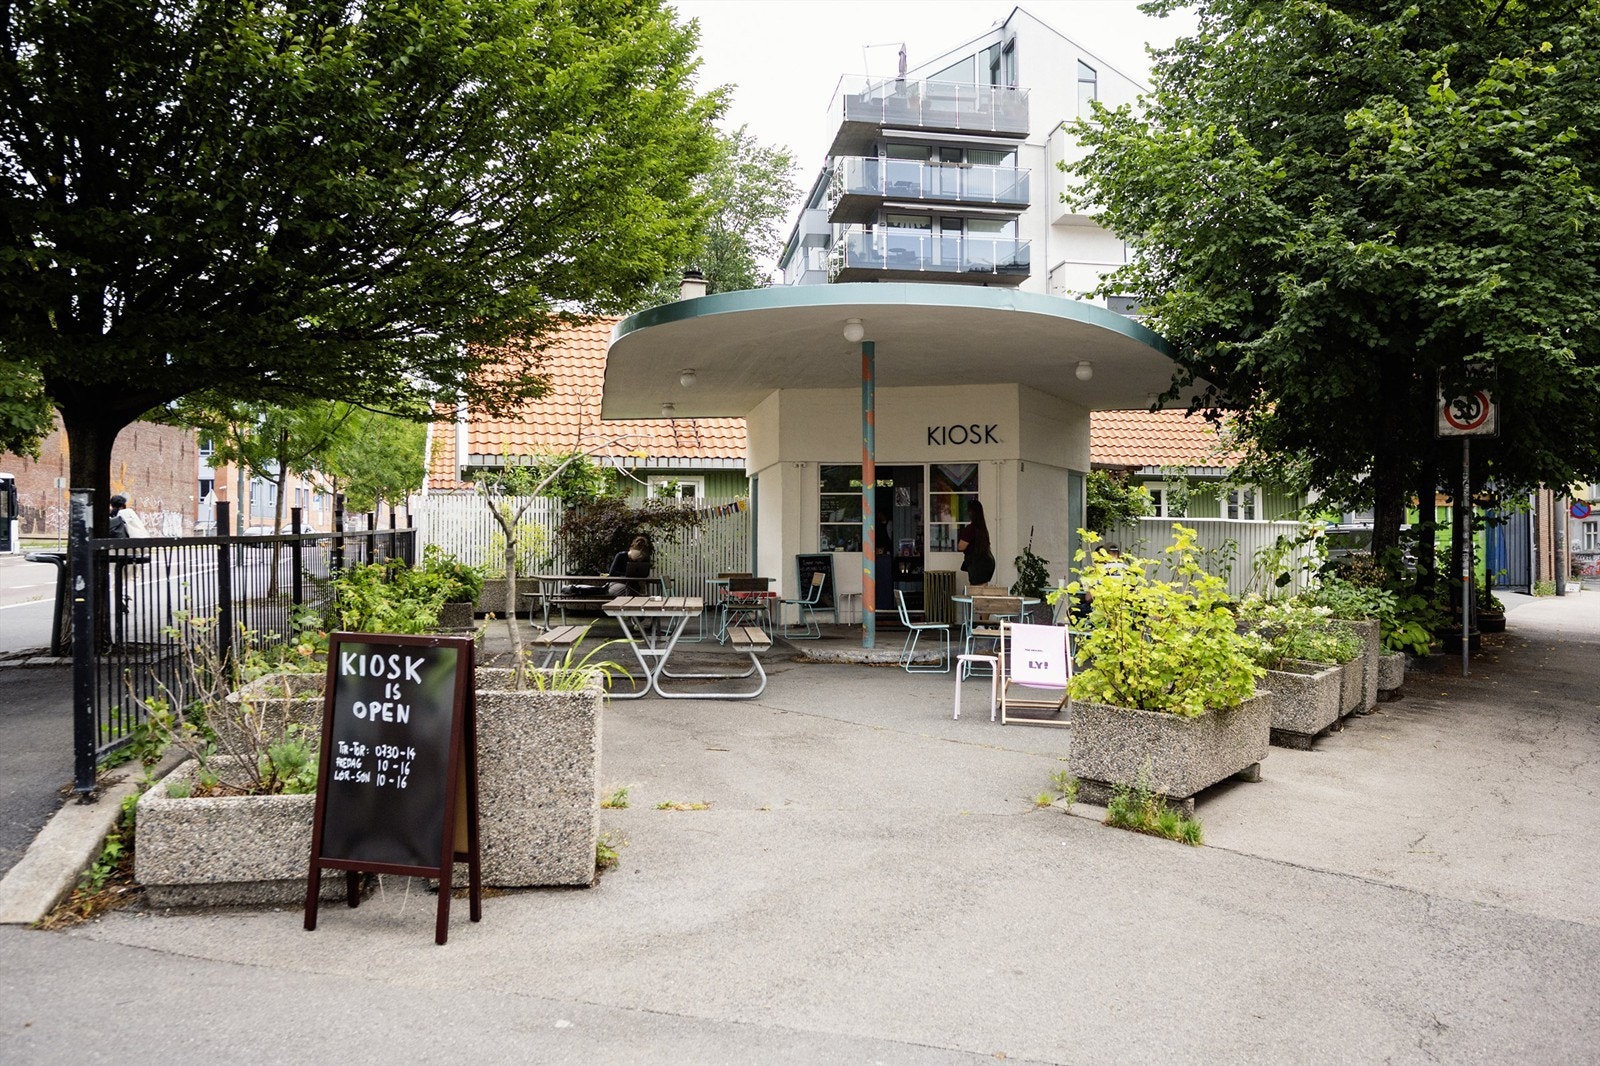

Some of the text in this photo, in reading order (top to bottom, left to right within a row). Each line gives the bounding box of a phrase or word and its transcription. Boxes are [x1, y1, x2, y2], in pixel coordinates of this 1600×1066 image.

[928, 424, 999, 446] KIOSK
[341, 652, 426, 685] KIOSK
[385, 682, 402, 700] IS
[352, 701, 411, 724] OPEN
